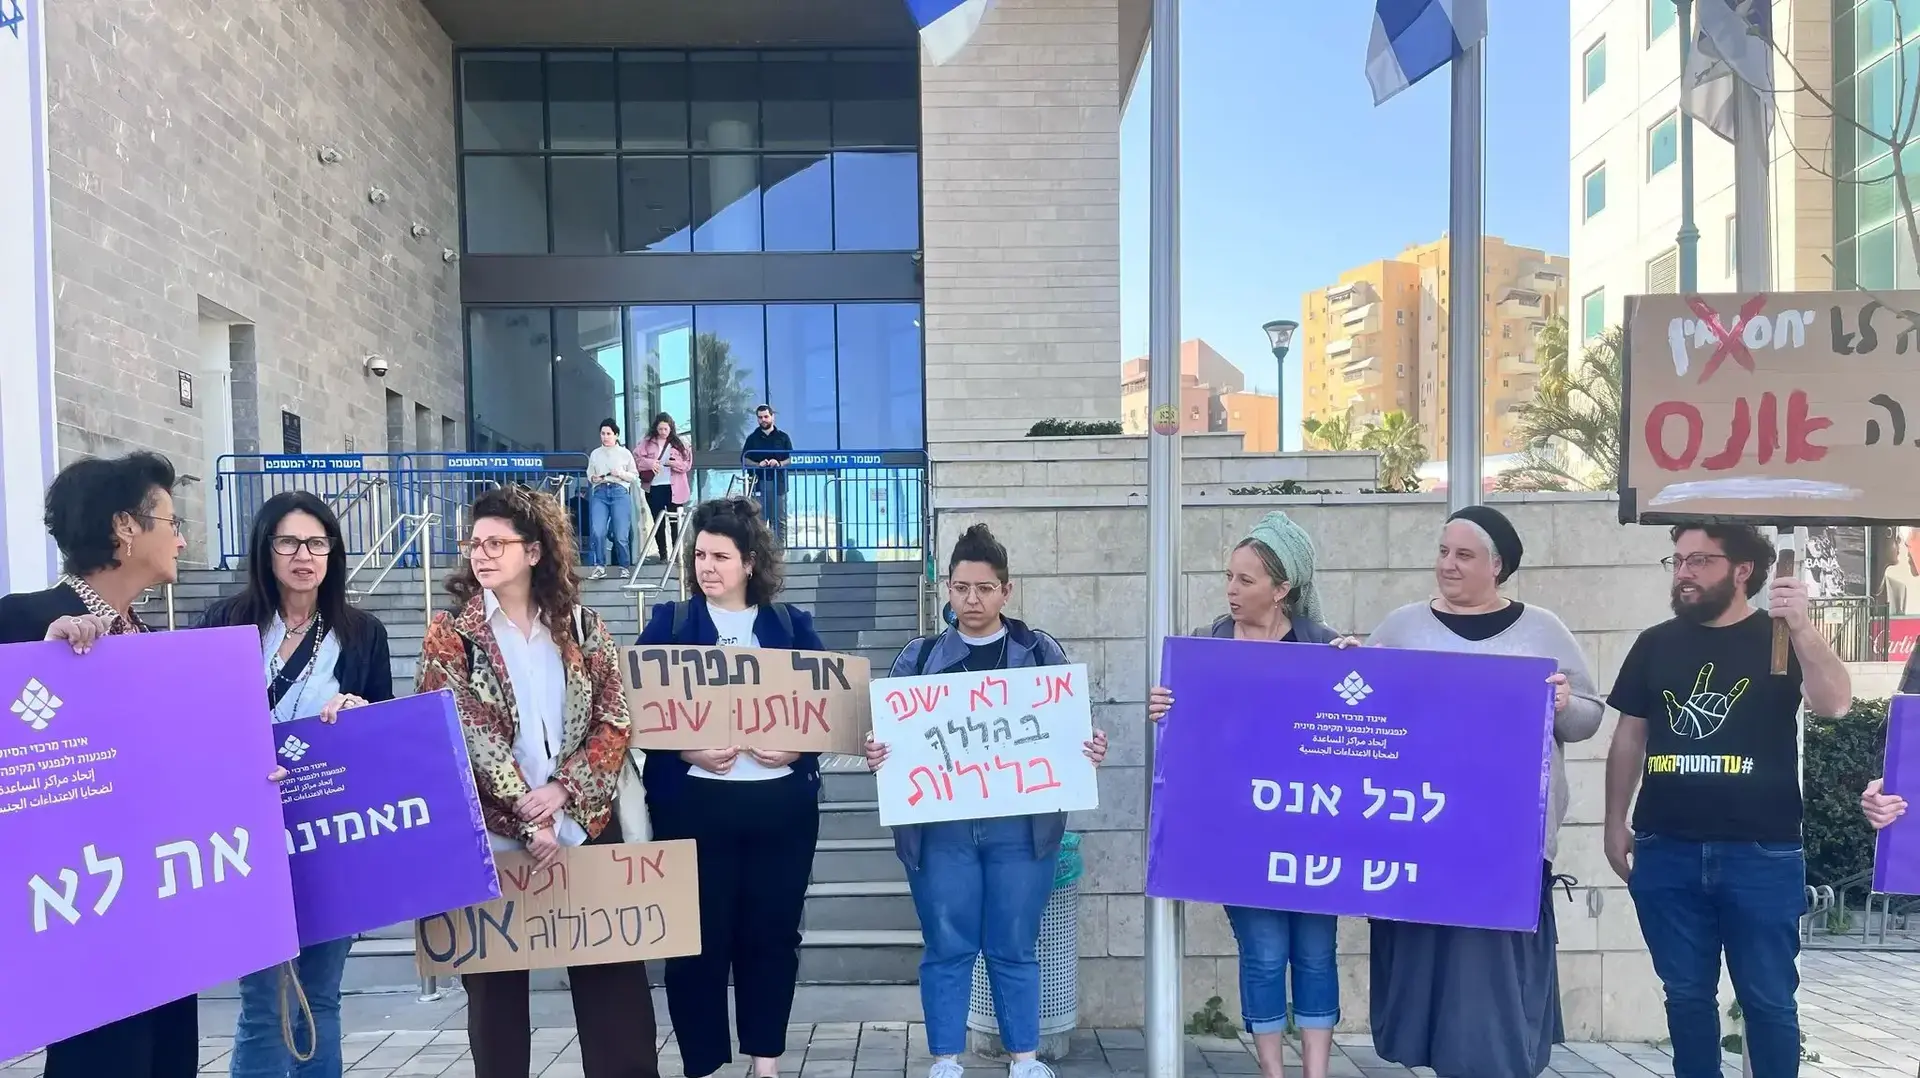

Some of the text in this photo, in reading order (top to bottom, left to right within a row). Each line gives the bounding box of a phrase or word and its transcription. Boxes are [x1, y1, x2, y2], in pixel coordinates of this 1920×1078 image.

[1644, 388, 1834, 471] אונס
[266, 460, 361, 469] משמר בתי המשפט
[448, 458, 542, 467] משמר בתי המשפט
[791, 455, 880, 464] משמר בתי המשפט
[628, 650, 851, 700] אל תפקירו
[885, 672, 1074, 721] אני לא ישנה
[1293, 721, 1408, 736] לנפגעות ולנפגעי תקיפה מינית
[1316, 712, 1387, 723] איגוד מרכזי הסיוע
[30, 741, 60, 752] מרכזי
[61, 736, 89, 748] איגוד
[0, 747, 117, 776] לנפגעות ולנפגעי תקיפה
[1251, 777, 1446, 824] לכל אנס
[28, 826, 252, 933] את לא
[611, 850, 665, 886] אל
[1267, 851, 1418, 892] יש שם
[420, 901, 519, 969] אנס
